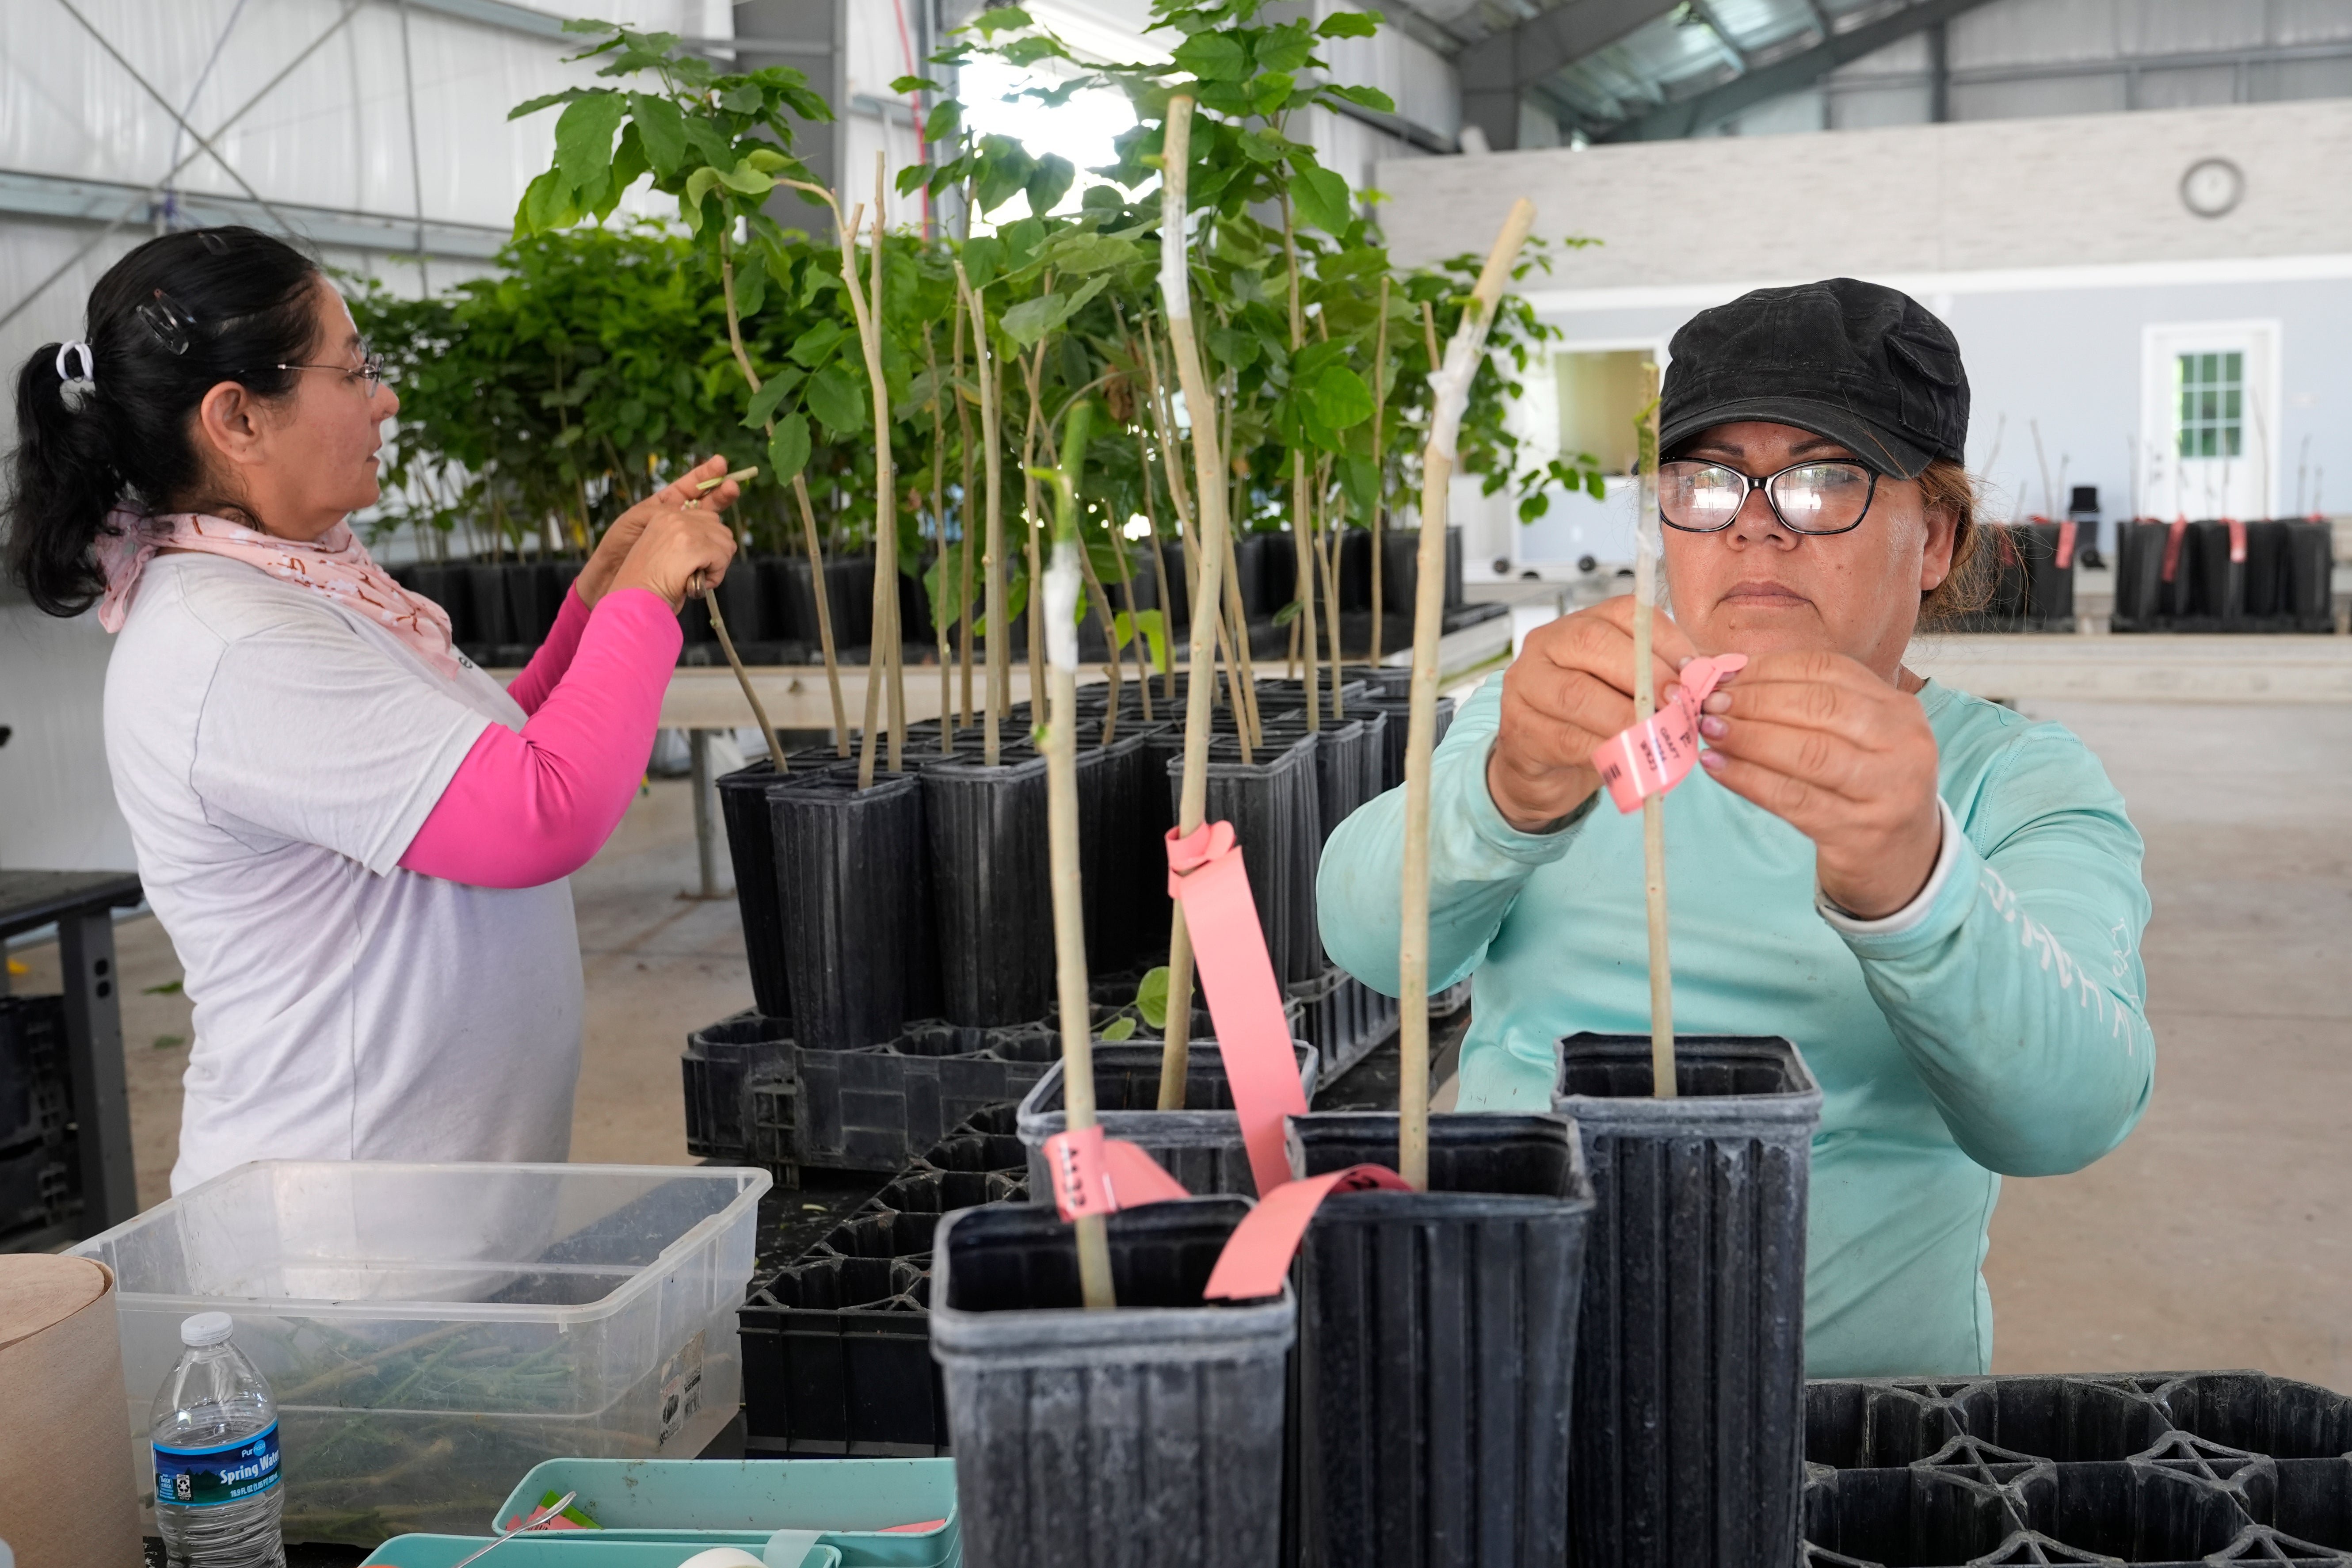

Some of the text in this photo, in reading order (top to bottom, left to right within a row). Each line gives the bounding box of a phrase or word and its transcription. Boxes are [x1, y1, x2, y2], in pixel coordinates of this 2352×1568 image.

[220, 1450, 279, 1485] Spring Water
[230, 1489, 241, 1498] 16.9
[240, 1487, 247, 1495] FL
[247, 1484, 253, 1493] OZ
